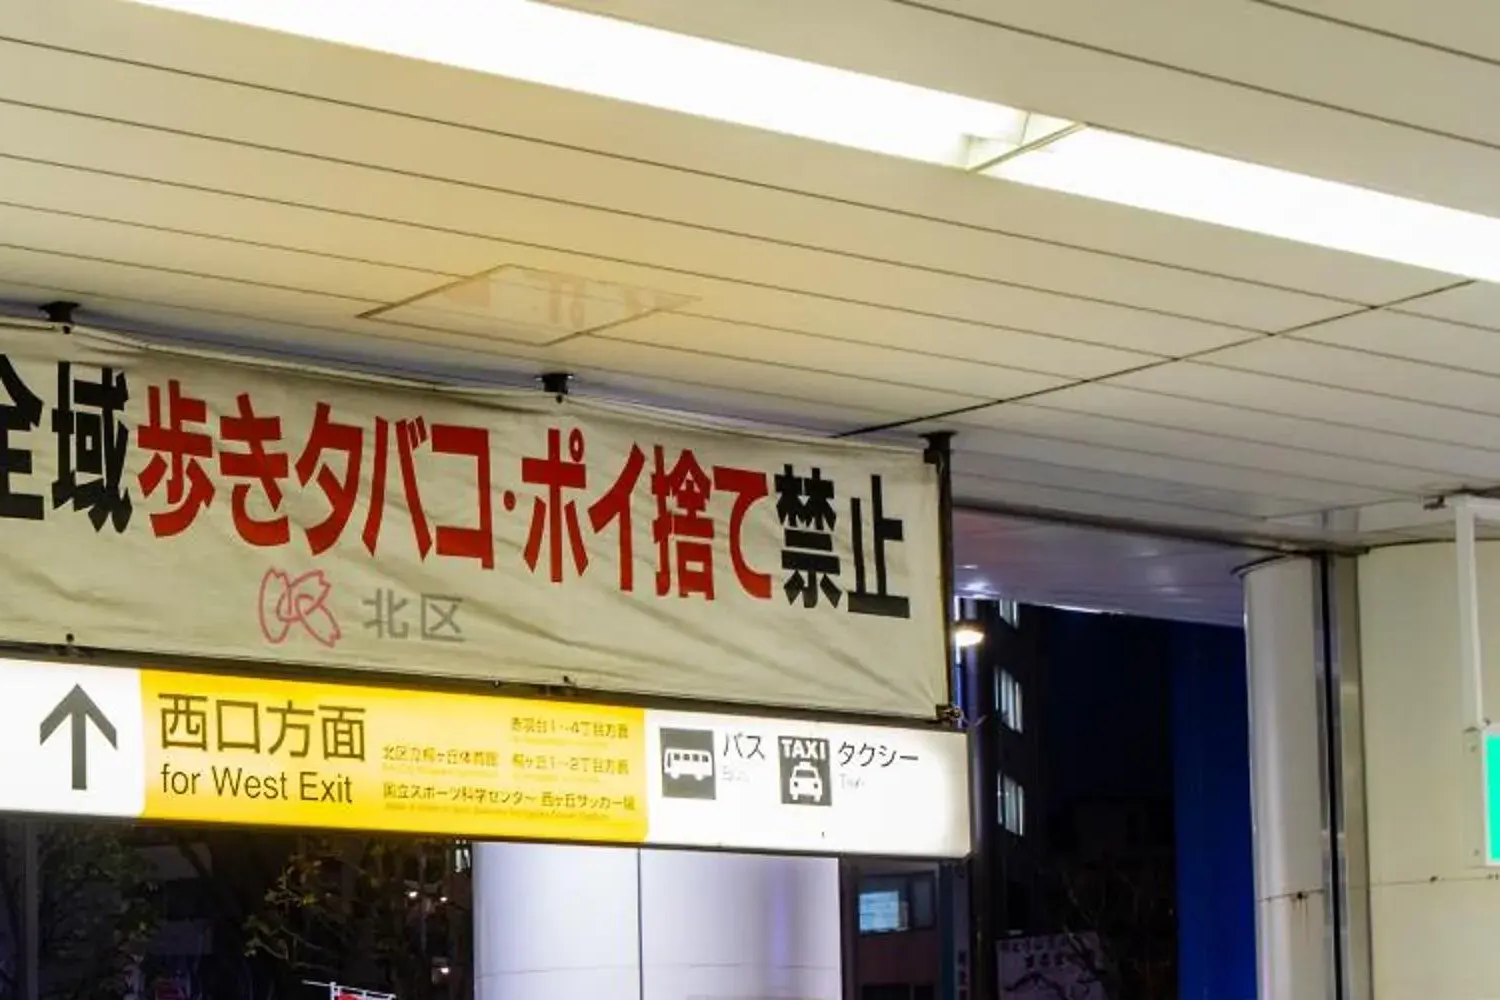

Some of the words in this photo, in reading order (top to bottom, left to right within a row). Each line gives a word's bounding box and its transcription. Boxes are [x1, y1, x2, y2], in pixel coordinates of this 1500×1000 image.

[362, 588, 466, 643] 北区
[157, 693, 367, 763] 西口方面
[722, 731, 766, 761] バス
[780, 738, 827, 760] TAXI
[837, 740, 920, 768] タクシー
[161, 763, 202, 795] for
[211, 765, 288, 801] West
[299, 771, 354, 804] Exit
